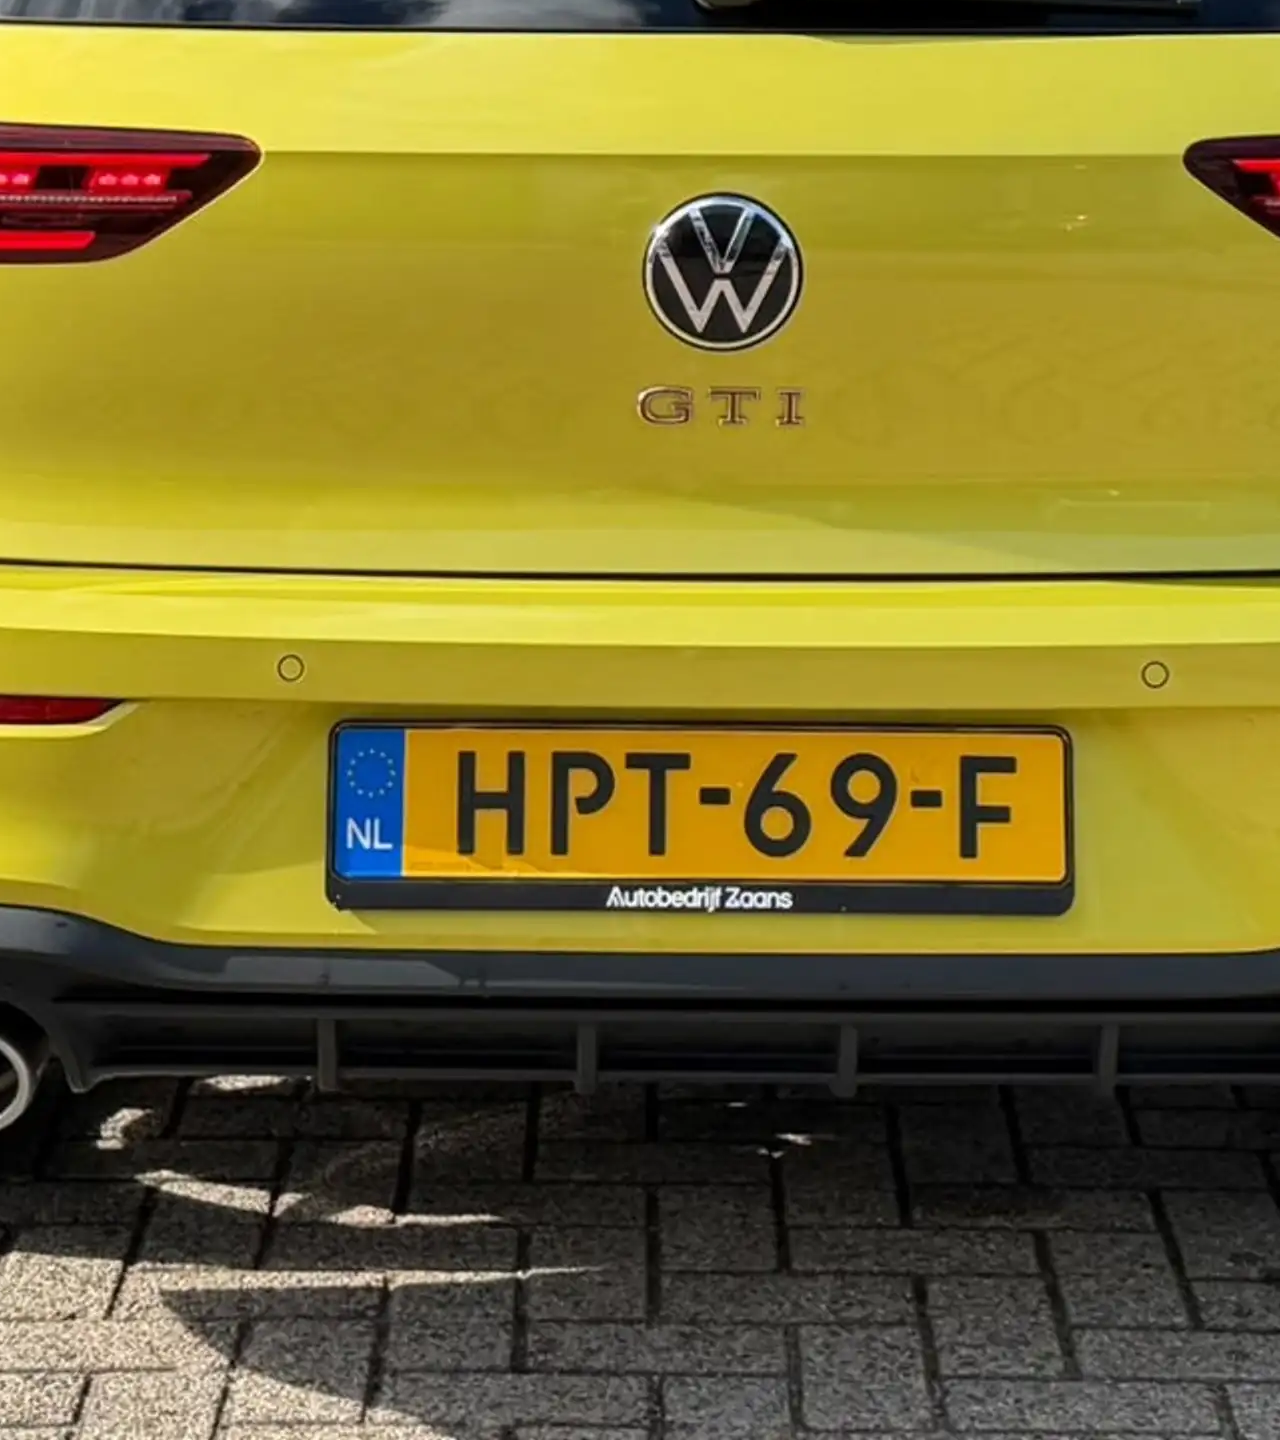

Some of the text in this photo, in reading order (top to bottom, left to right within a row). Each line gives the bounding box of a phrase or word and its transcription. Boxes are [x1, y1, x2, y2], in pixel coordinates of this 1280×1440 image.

[652, 205, 790, 335] VW
[637, 385, 805, 426] GTI
[456, 750, 1017, 858] HPT-69-F
[346, 817, 393, 851] NL
[606, 885, 794, 912] Autobedrijf Zaans
